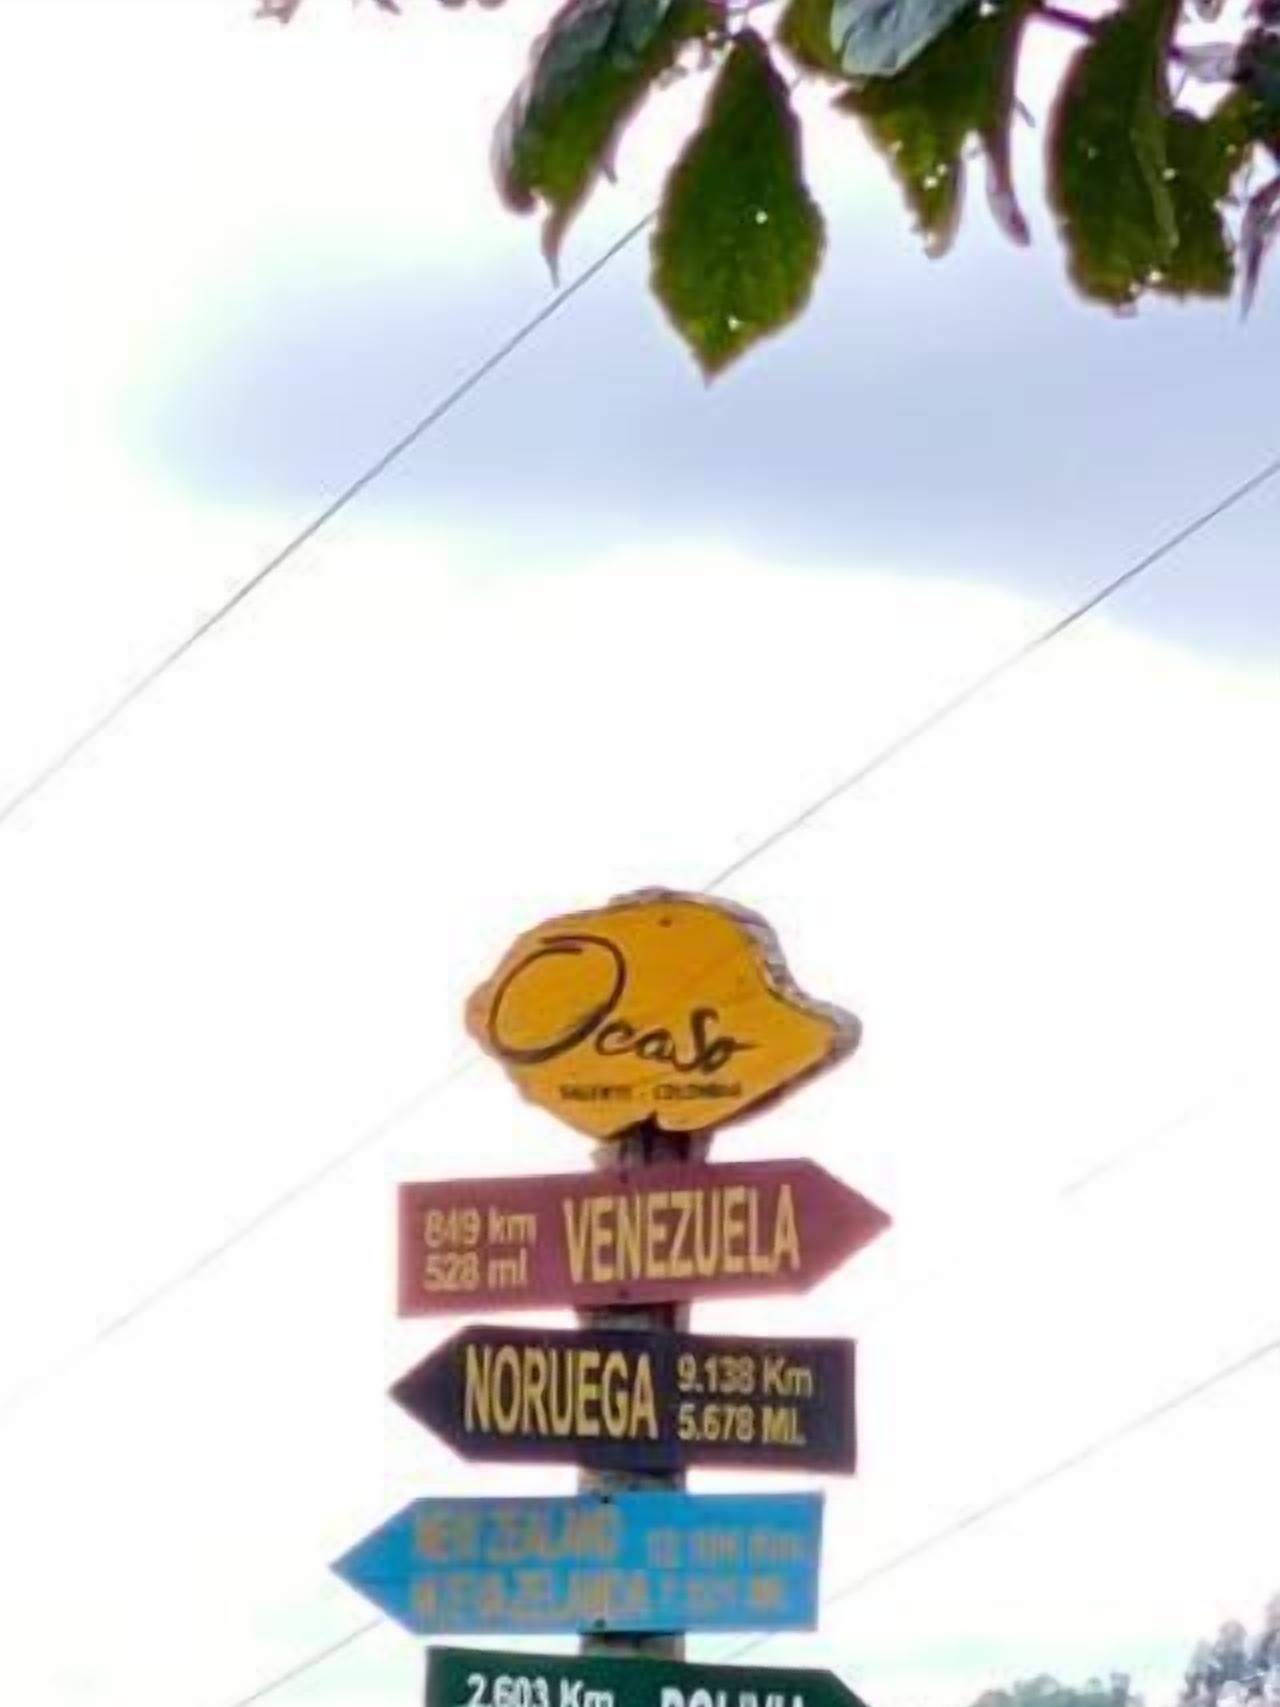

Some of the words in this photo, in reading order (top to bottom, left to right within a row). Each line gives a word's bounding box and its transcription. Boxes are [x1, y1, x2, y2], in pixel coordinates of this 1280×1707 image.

[487, 1205, 537, 1245] km
[564, 1185, 800, 1284] VENEZUELA
[424, 1252, 480, 1291] 528
[462, 1343, 658, 1440] NORUEGA
[677, 1353, 755, 1394] 9.138
[763, 1355, 812, 1398] Km
[678, 1401, 755, 1443] 5.678
